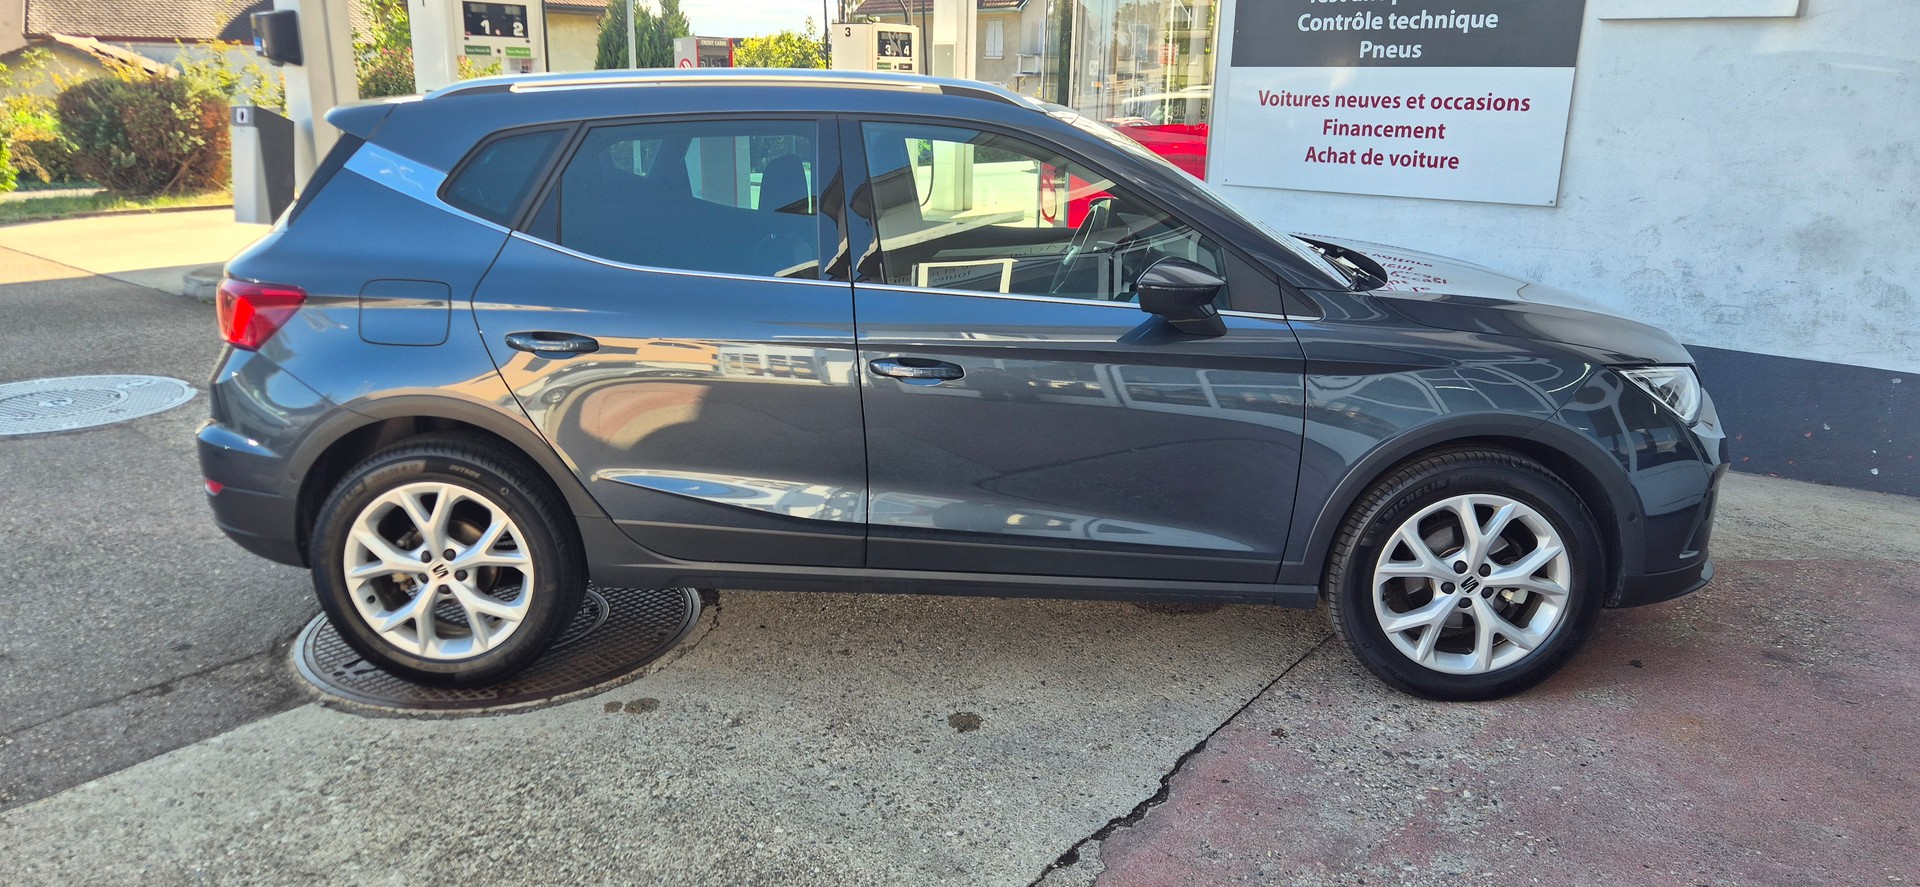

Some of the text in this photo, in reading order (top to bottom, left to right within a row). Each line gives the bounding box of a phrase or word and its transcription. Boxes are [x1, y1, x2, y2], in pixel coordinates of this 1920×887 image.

[480, 19, 525, 37] 1 2
[1298, 9, 1499, 33] Contrôle technique
[844, 27, 851, 37] 3
[884, 44, 910, 56] 3 4
[1359, 41, 1422, 59] Pneus
[1258, 90, 1531, 112] Voitures neuves et occasions
[1322, 119, 1446, 139] Financement
[1304, 147, 1460, 169] Achat de voiture
[1384, 479, 1449, 521] MICHELIN
